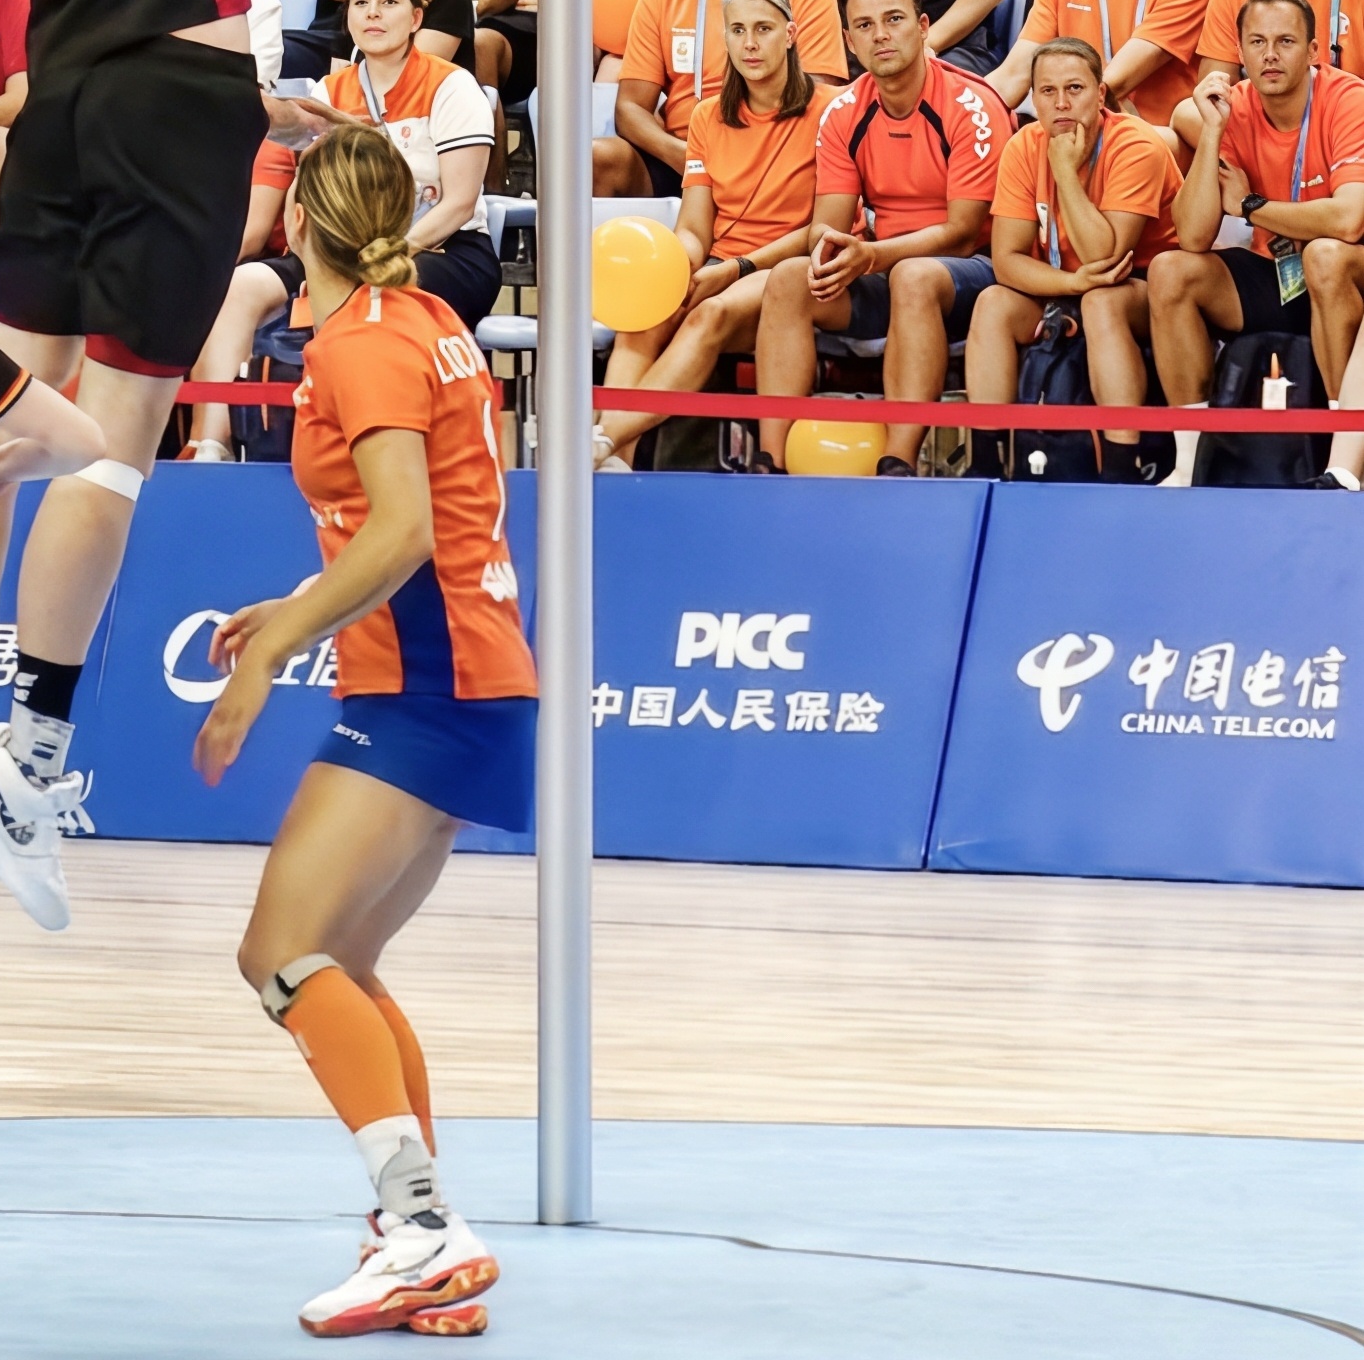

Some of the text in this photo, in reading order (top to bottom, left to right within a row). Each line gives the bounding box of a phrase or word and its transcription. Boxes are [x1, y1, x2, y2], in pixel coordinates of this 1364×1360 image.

[675, 611, 811, 671] PICC
[1128, 638, 1347, 711] 中国电信
[591, 682, 885, 733] 中国人民保险
[1121, 712, 1337, 740] CHINA TELECOM
